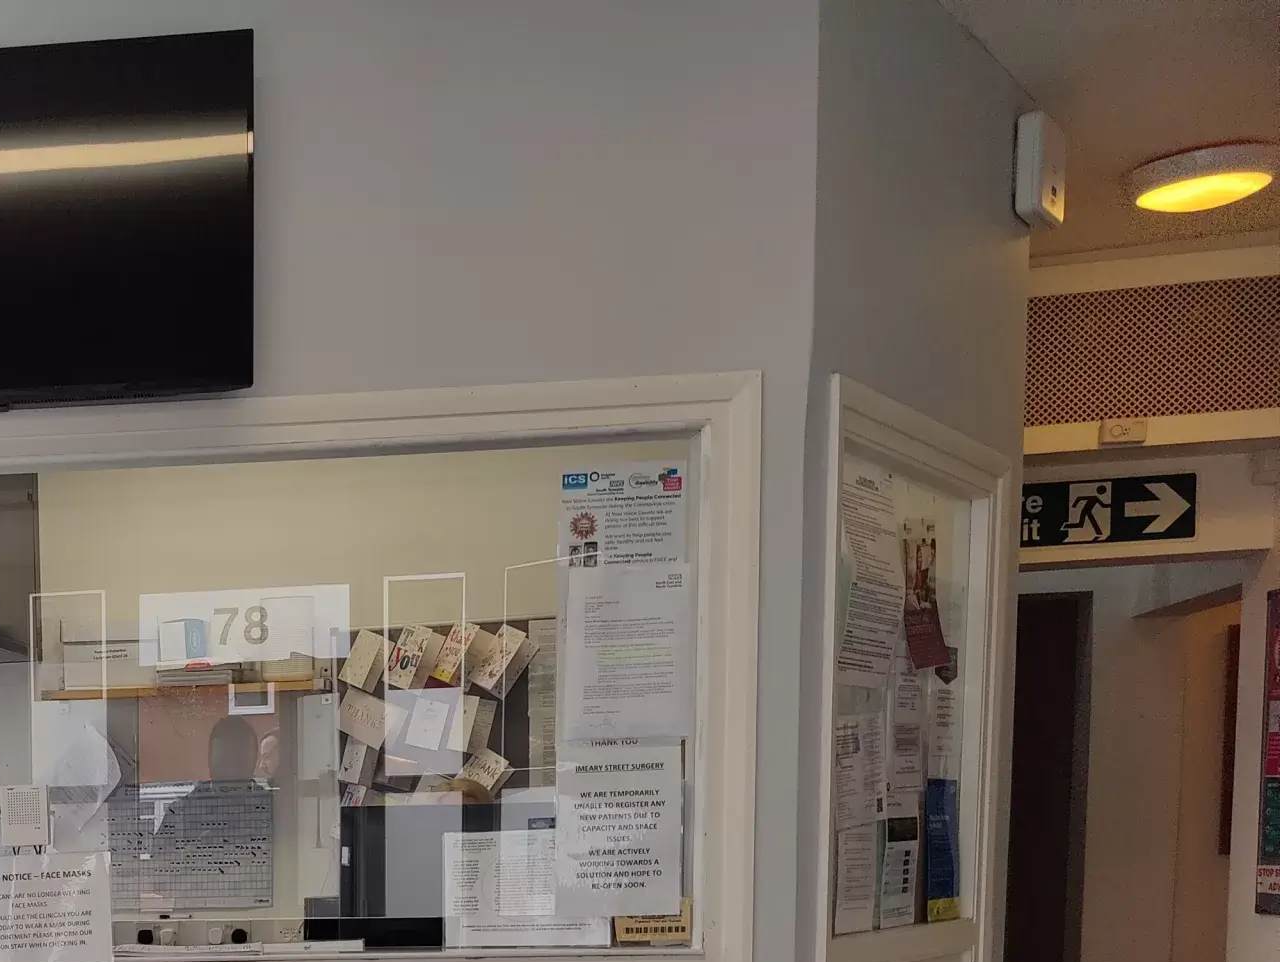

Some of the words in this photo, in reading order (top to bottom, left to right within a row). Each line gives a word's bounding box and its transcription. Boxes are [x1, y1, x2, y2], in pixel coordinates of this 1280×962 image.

[1022, 518, 1041, 541] it
[213, 605, 269, 645] 78
[575, 765, 603, 773] IMEARY
[604, 764, 631, 772] STREET
[631, 762, 664, 771] SURGERY
[609, 789, 660, 797] TEMPORARILY
[574, 802, 603, 810] UNABLE
[598, 813, 632, 821] PATIENTS
[633, 812, 648, 820] DUE
[650, 811, 661, 819] TO
[581, 825, 616, 833] CAPACITY
[606, 835, 632, 843] ISSUES.
[601, 848, 616, 856] ARE
[579, 860, 615, 868] WORKING
[616, 858, 653, 866] TOWARDS
[653, 858, 660, 866] A
[2, 872, 32, 882] NOTICE
[40, 871, 61, 879] FACE
[62, 869, 92, 879] MASKS
[576, 871, 612, 879] SOLUTION
[631, 869, 651, 877] HOPE
[1275, 868, 1280, 877] S
[591, 882, 623, 890] RE-OPEN
[623, 881, 647, 889] SOON.
[37, 890, 61, 898] LONGER
[32, 931, 54, 939] PLEASE
[54, 930, 78, 938] INFORM
[28, 941, 48, 949] WHEN
